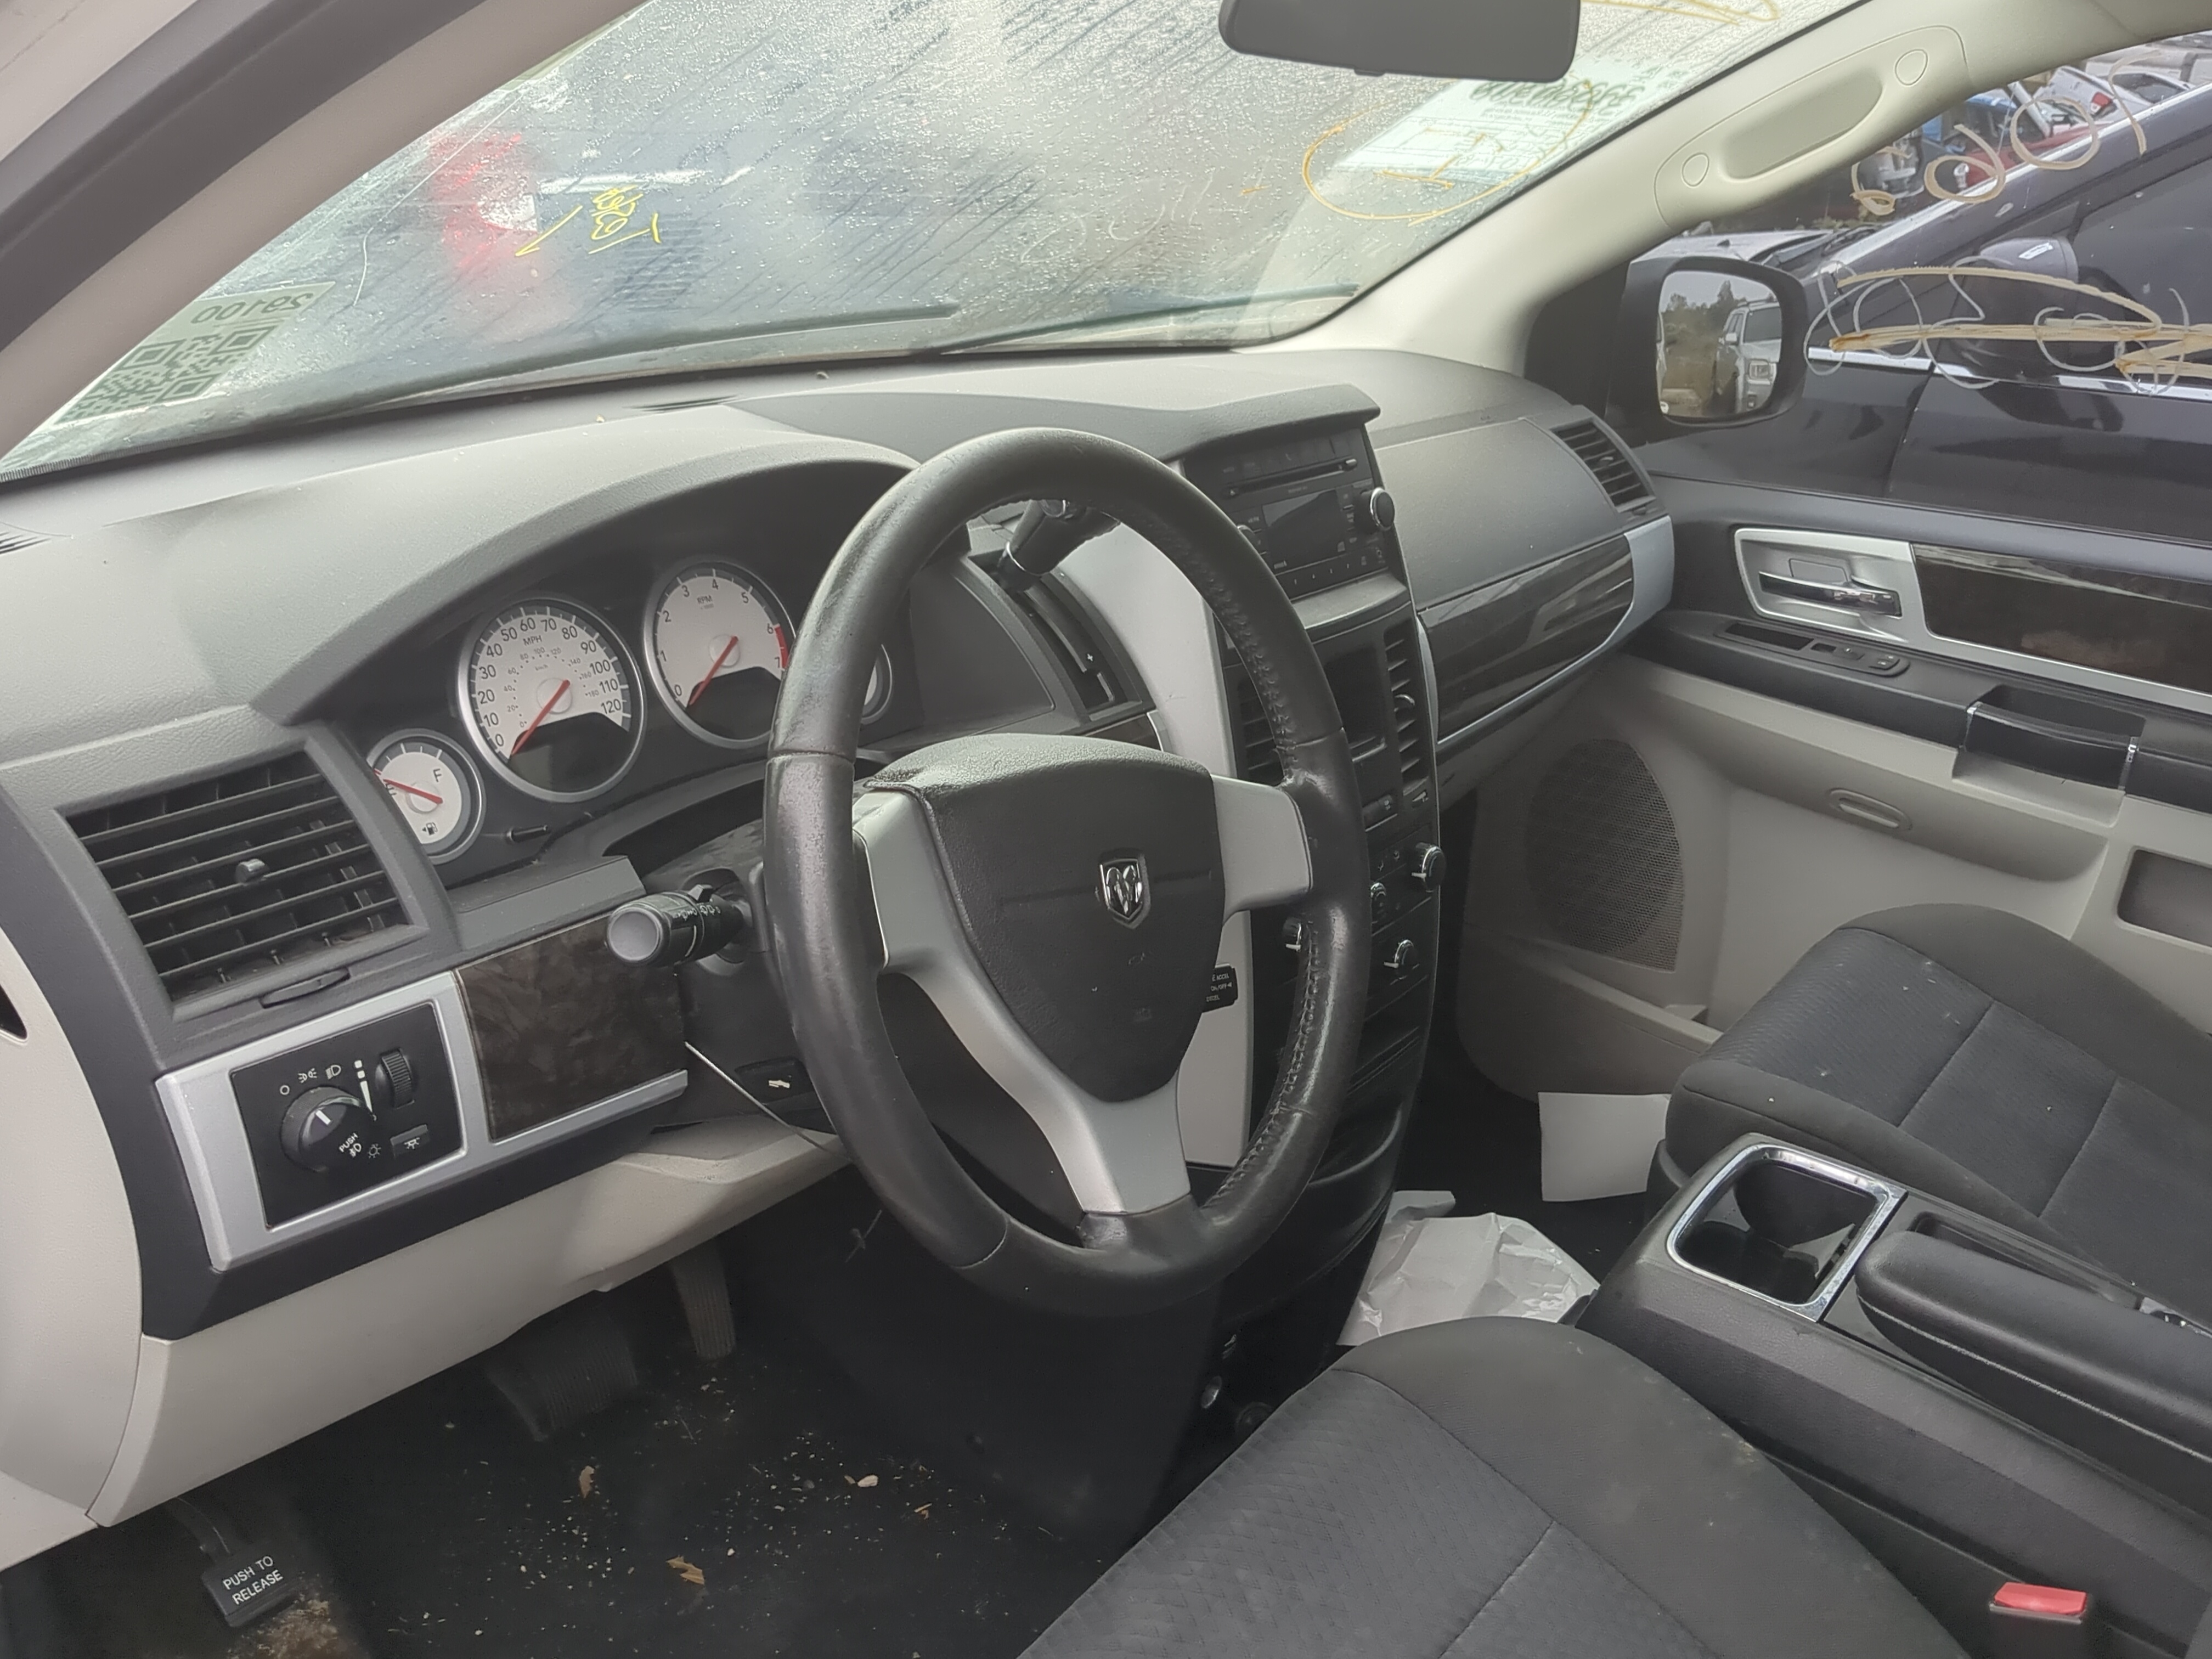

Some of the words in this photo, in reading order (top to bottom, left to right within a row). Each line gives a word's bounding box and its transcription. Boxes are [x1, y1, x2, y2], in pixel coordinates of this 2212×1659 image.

[681, 585, 690, 597] 3
[712, 579, 719, 590] 4
[697, 595, 713, 604] RPM
[741, 591, 749, 603] 5
[663, 610, 672, 623] 2
[520, 617, 536, 632] 60
[540, 618, 557, 632] 70
[767, 623, 774, 634] 6
[501, 627, 517, 642] 50
[562, 625, 578, 640] 80
[523, 635, 543, 646] MPH
[580, 640, 597, 654] 90
[486, 643, 503, 657] 40
[550, 647, 562, 655] 120
[661, 650, 667, 662] 1
[589, 659, 611, 675] 100
[775, 657, 780, 668] 7
[479, 664, 496, 680] 30
[580, 671, 592, 679] 160
[599, 678, 619, 693] 110
[674, 684, 682, 696] 0
[477, 689, 495, 704] 20
[601, 698, 622, 714] 120
[483, 712, 499, 727] 10
[495, 733, 504, 747] 0
[433, 768, 442, 782] F
[1210, 983, 1227, 991] ON/OFF
[338, 1132, 358, 1152] PUSH
[222, 1566, 255, 1590] PUSH
[255, 1556, 274, 1570] TO
[232, 1570, 284, 1605] RELEASE
